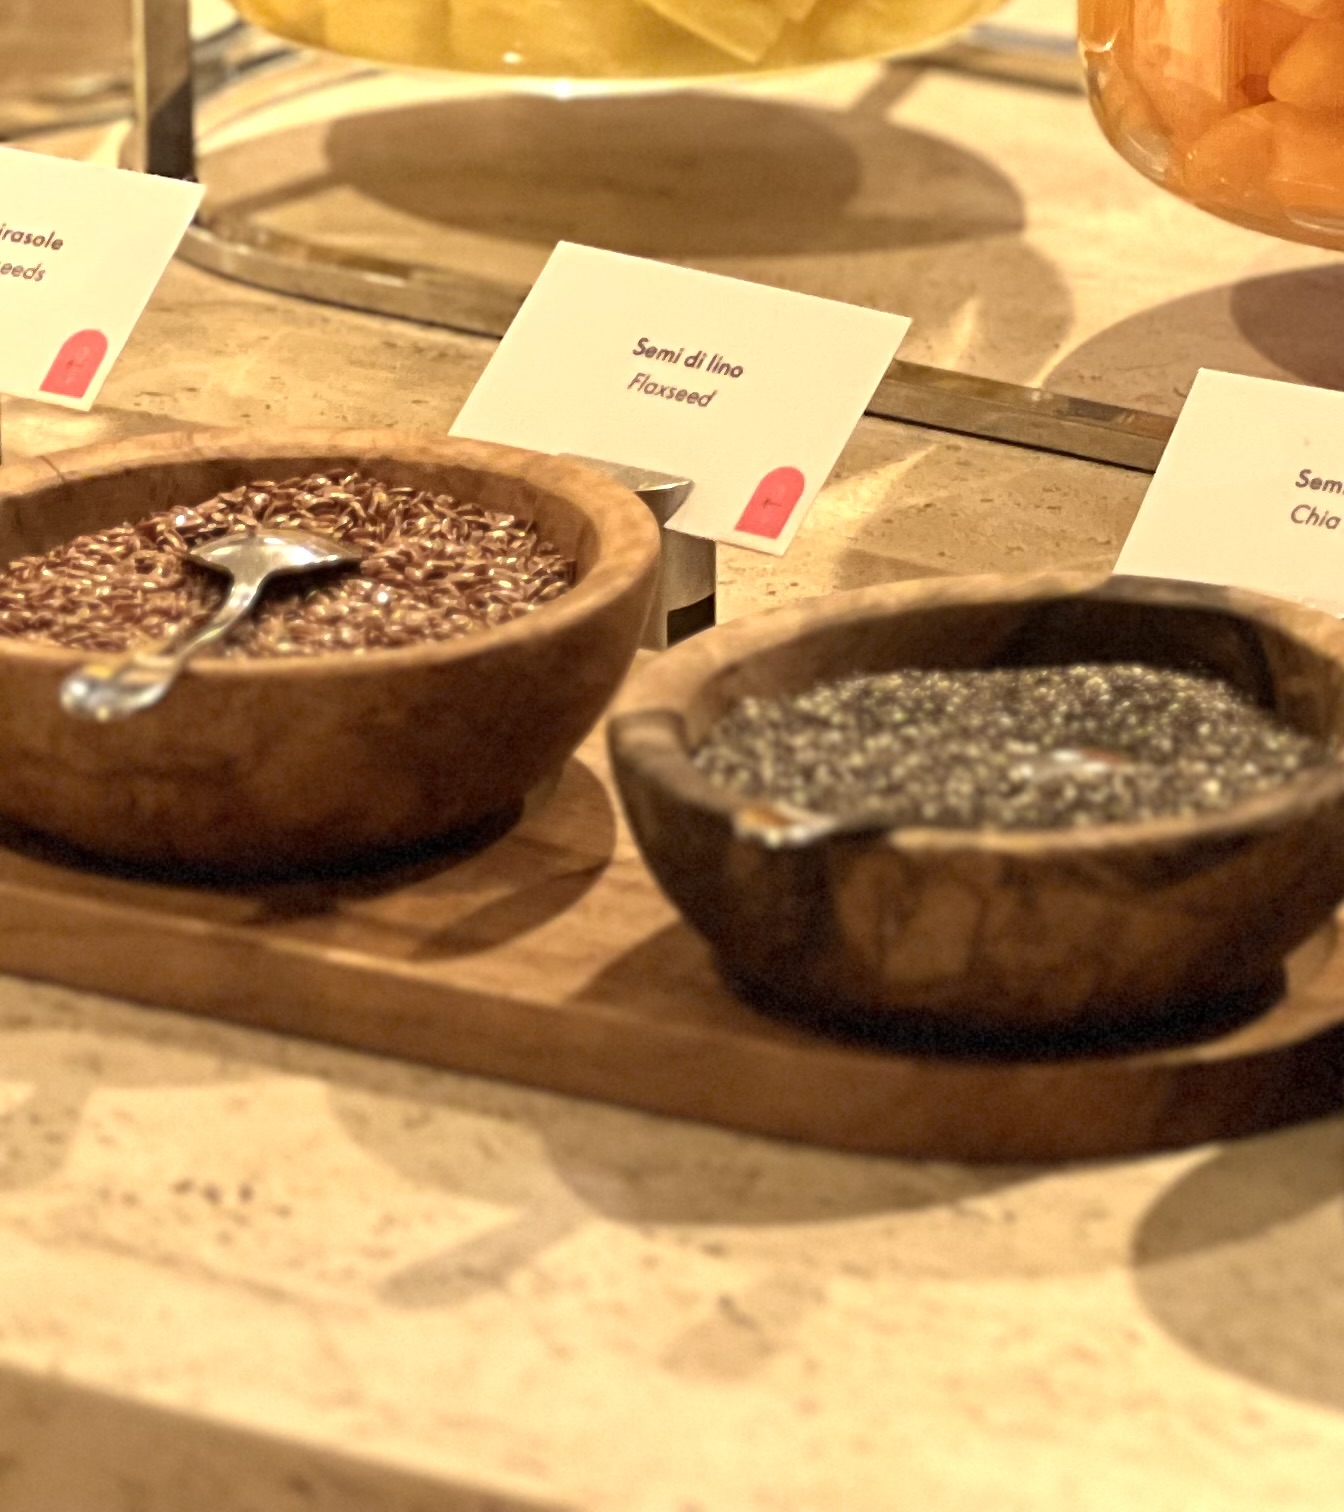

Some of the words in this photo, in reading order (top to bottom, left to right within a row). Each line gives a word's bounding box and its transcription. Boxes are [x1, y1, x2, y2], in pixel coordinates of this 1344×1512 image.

[0, 261, 46, 282] eeds
[632, 337, 685, 364] Semi
[683, 350, 708, 369] di
[706, 353, 744, 378] lino
[627, 372, 718, 408] Flaxseed
[1290, 504, 1342, 529] Chia
